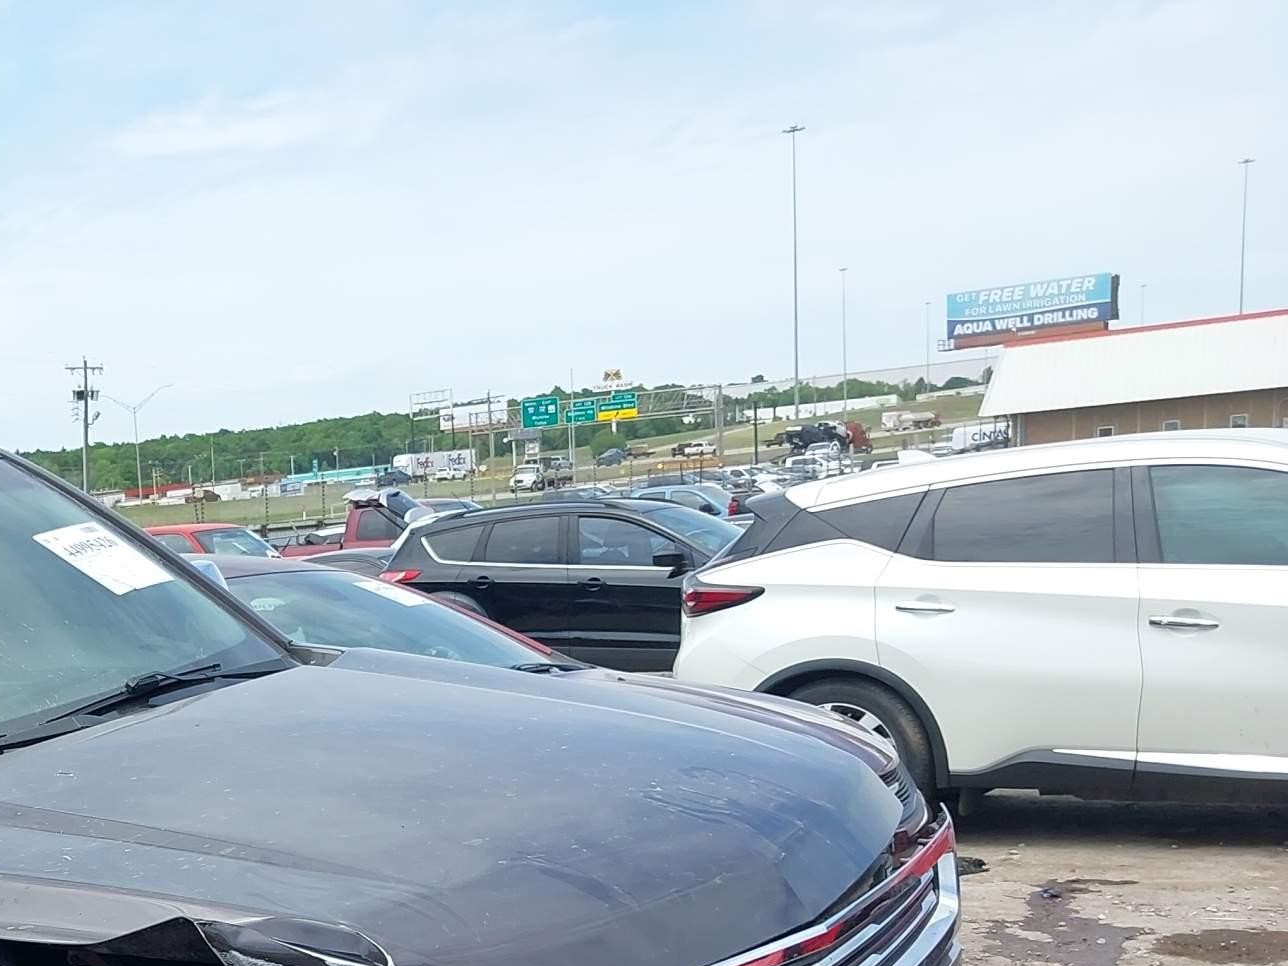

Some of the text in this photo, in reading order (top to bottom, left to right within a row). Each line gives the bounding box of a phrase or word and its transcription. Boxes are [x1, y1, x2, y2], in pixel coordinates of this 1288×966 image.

[957, 276, 1096, 305] GET FREE WATER
[965, 293, 1086, 317] FOR LAWN IRRIGATION
[953, 307, 1098, 336] AQUA WELL DRILLING
